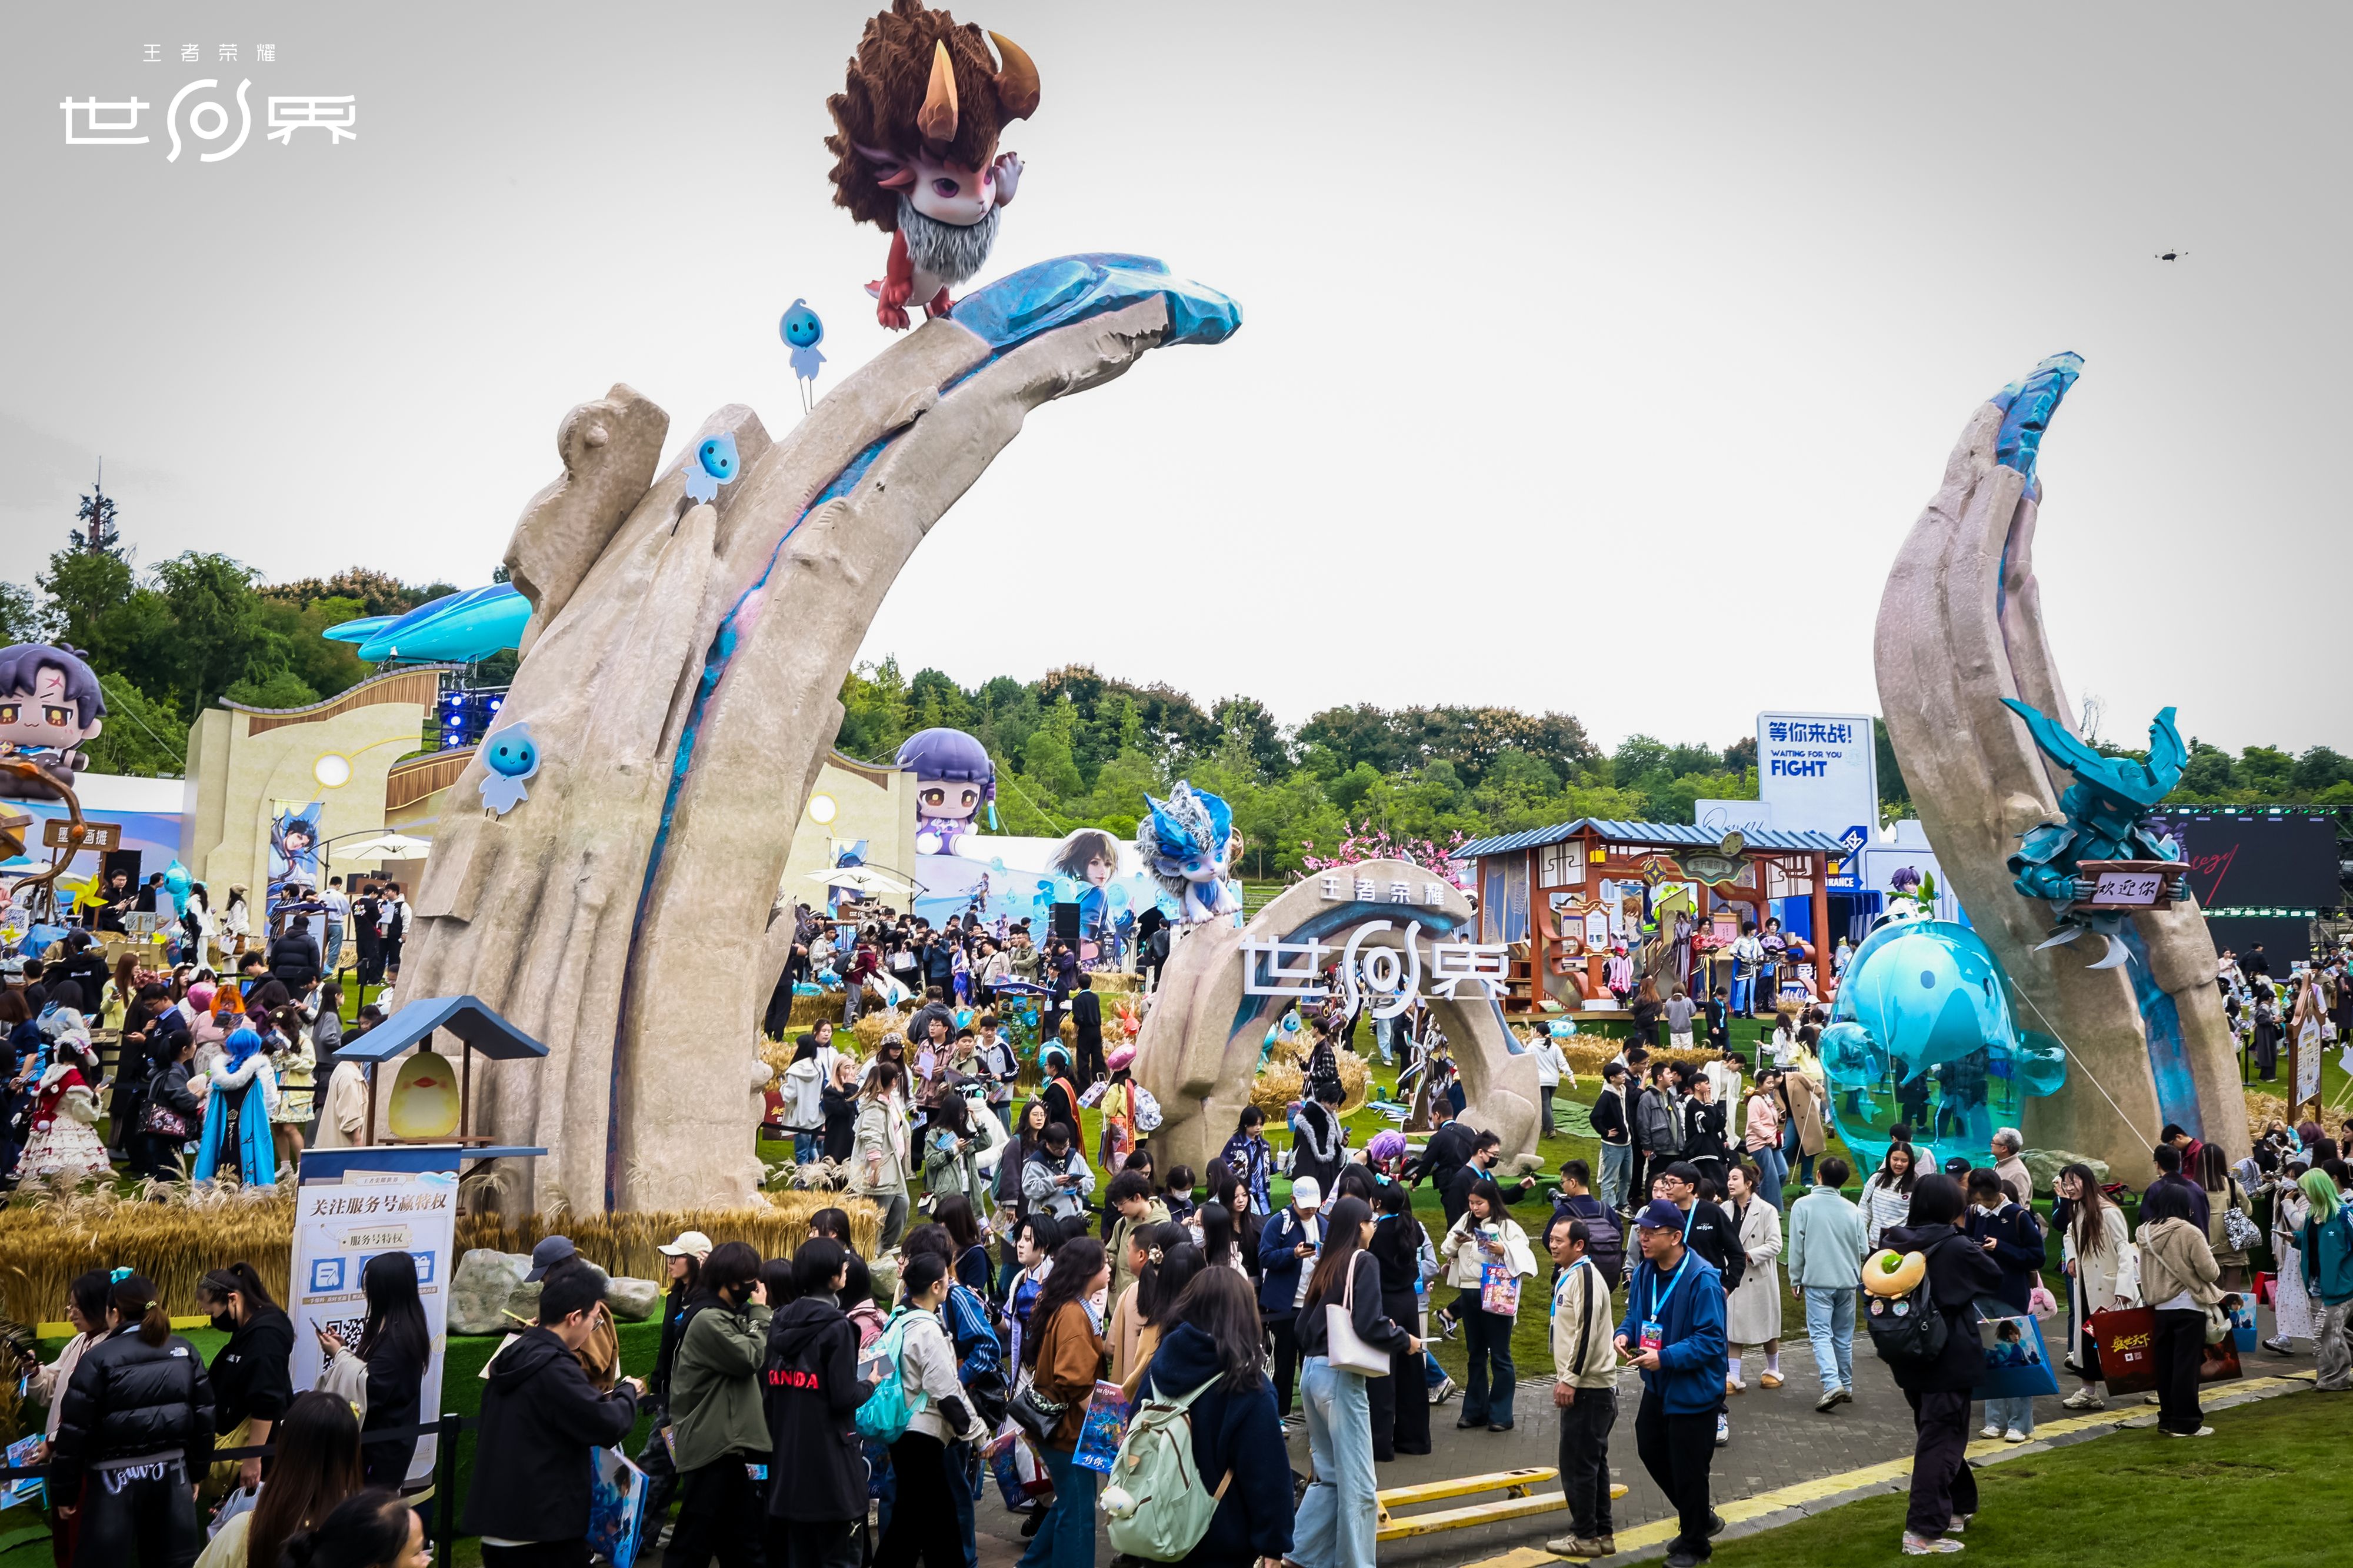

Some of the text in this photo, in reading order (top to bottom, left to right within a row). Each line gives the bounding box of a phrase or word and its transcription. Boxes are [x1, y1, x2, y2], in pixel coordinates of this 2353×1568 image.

[1769, 721, 1852, 744] 等你来战!
[1771, 759, 1827, 777] FIGHT
[1320, 876, 1445, 906] 王者荣耀
[2098, 879, 2157, 897] 欢迎你
[309, 1193, 448, 1217] 关注服务号赢特权
[349, 1232, 404, 1246] 服务号特权
[2111, 1332, 2151, 1353] 盛世天下
